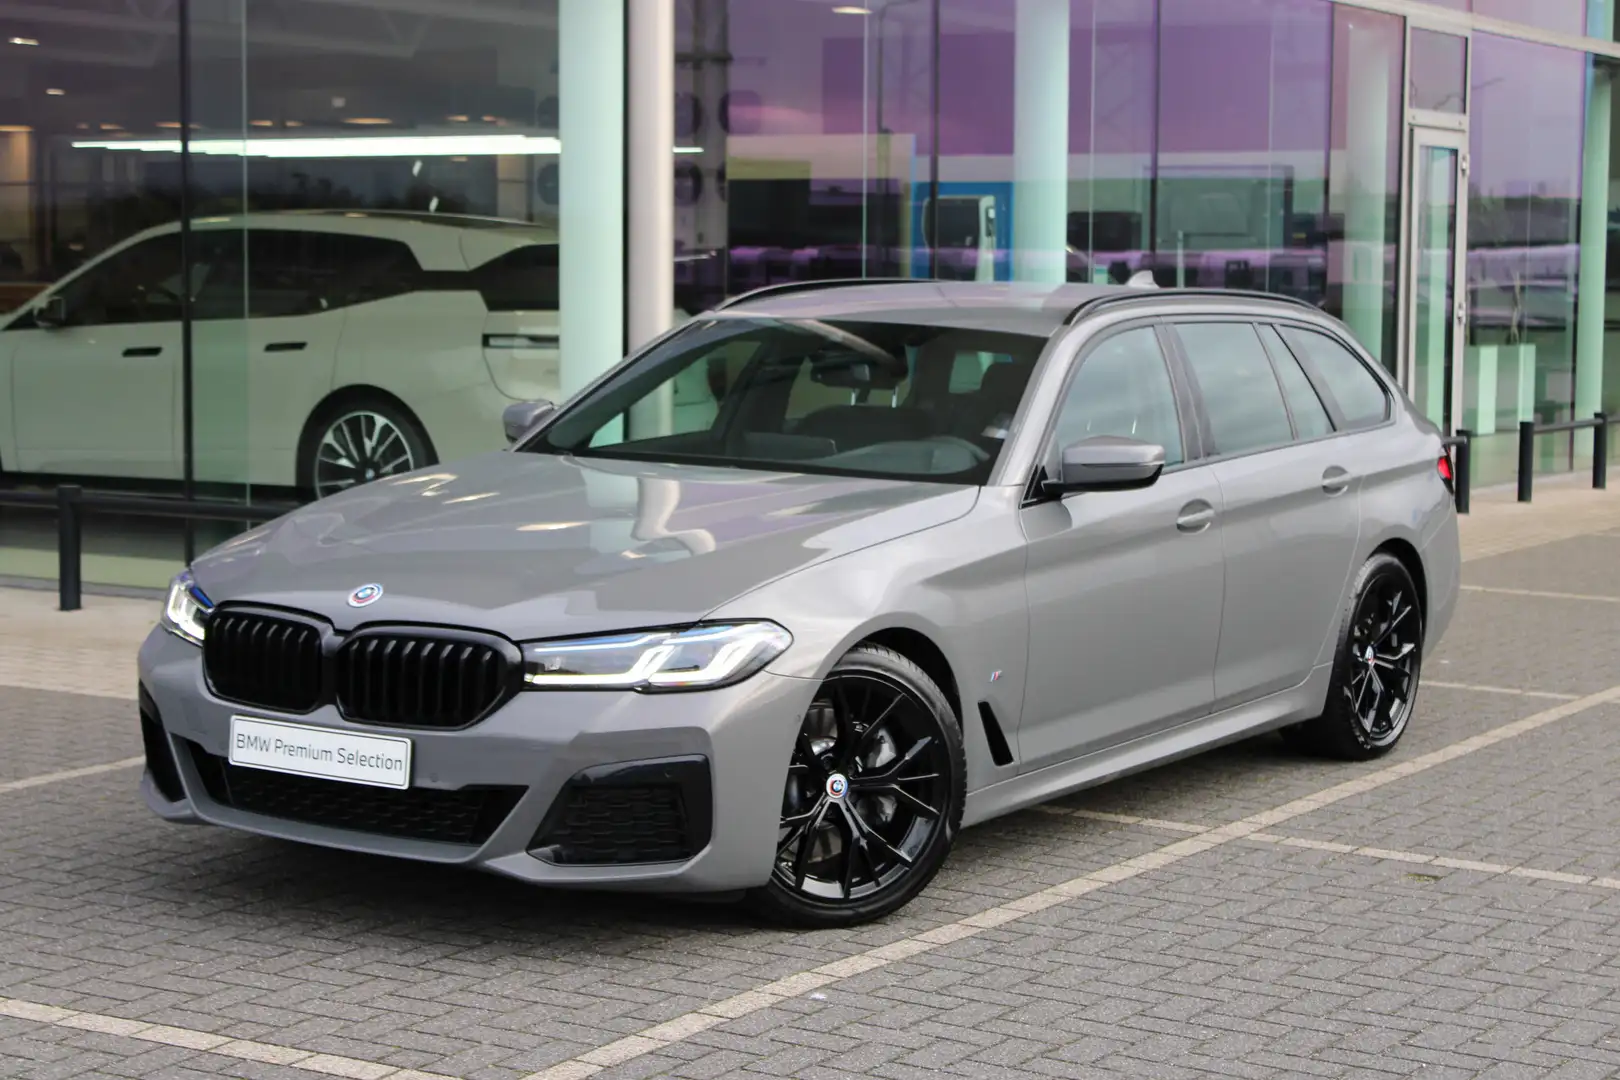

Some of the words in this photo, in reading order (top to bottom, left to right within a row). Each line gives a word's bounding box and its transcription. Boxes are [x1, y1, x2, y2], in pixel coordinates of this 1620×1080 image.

[236, 733, 271, 753] BMW
[274, 738, 333, 762] Premium
[337, 747, 403, 771] Selection
